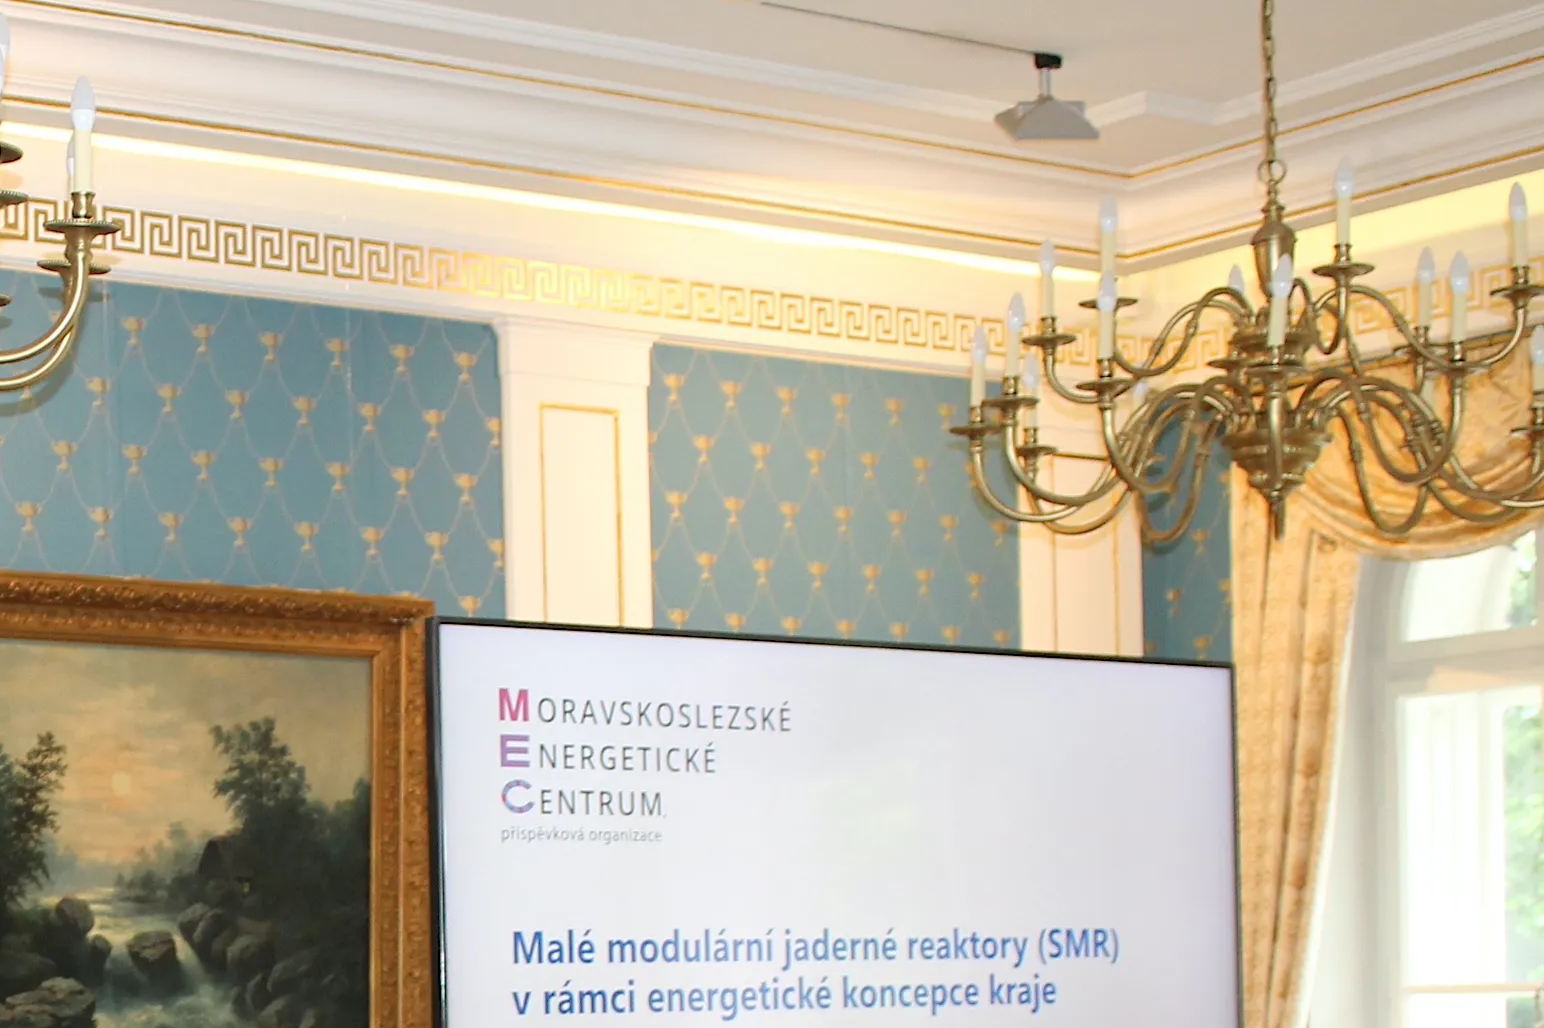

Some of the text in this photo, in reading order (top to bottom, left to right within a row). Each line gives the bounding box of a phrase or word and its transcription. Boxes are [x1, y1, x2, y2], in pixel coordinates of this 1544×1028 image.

[498, 687, 792, 732] MORAVSKOSLEZSKÉ
[500, 734, 716, 773] ENERGETICKÉ
[501, 826, 662, 845] příspěvková organizace
[512, 928, 1120, 971] Malé modulární jaderné reaktory (SMR)
[512, 973, 1057, 1021] v rámci energetické koncepce kraje
